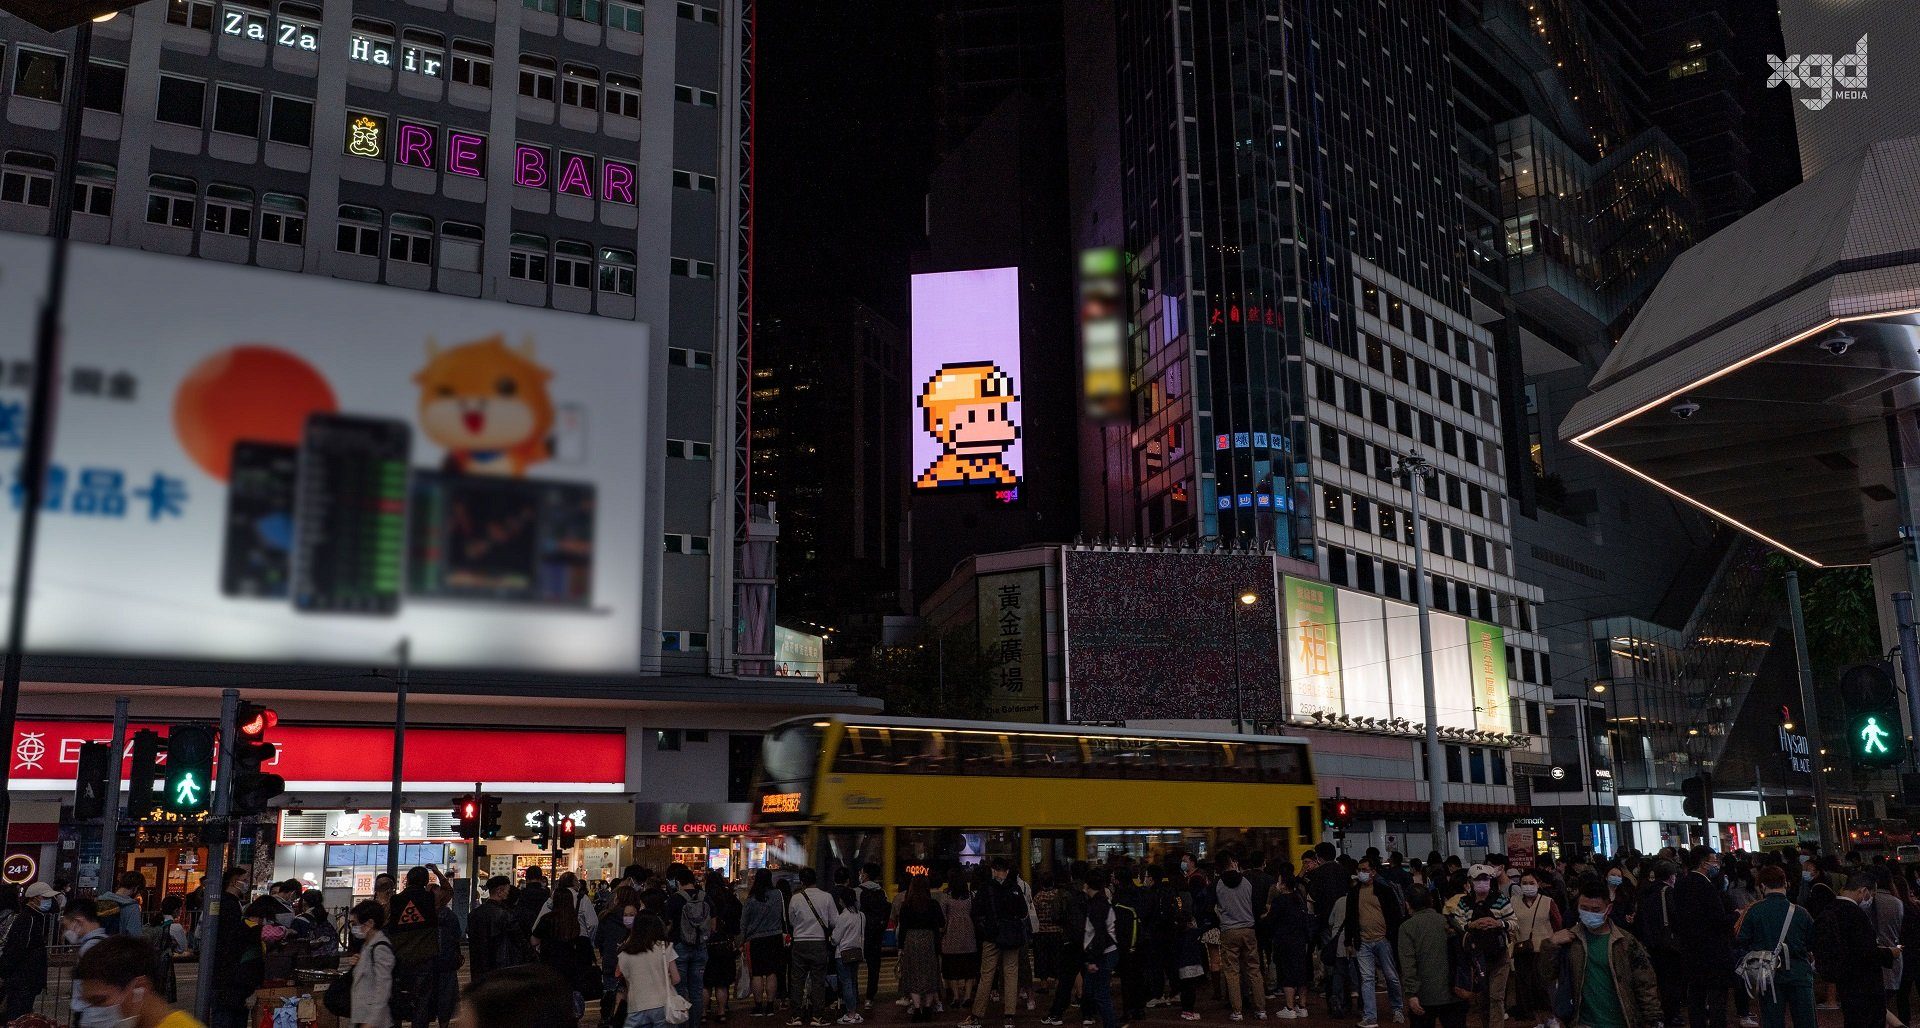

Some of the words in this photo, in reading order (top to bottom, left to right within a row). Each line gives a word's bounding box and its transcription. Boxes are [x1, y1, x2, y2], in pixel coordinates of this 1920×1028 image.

[352, 37, 441, 76] Hair
[400, 125, 482, 176] RE
[515, 147, 633, 202] BAR
[996, 486, 1018, 503] xgd
[998, 584, 1024, 693] 黃金廣場
[1299, 619, 1329, 676] 租
[1778, 725, 1809, 760] Hysan
[660, 824, 678, 833] BEE
[683, 824, 717, 833] CHENG
[1514, 816, 1545, 824] oldmark
[8, 866, 21, 874] 24
